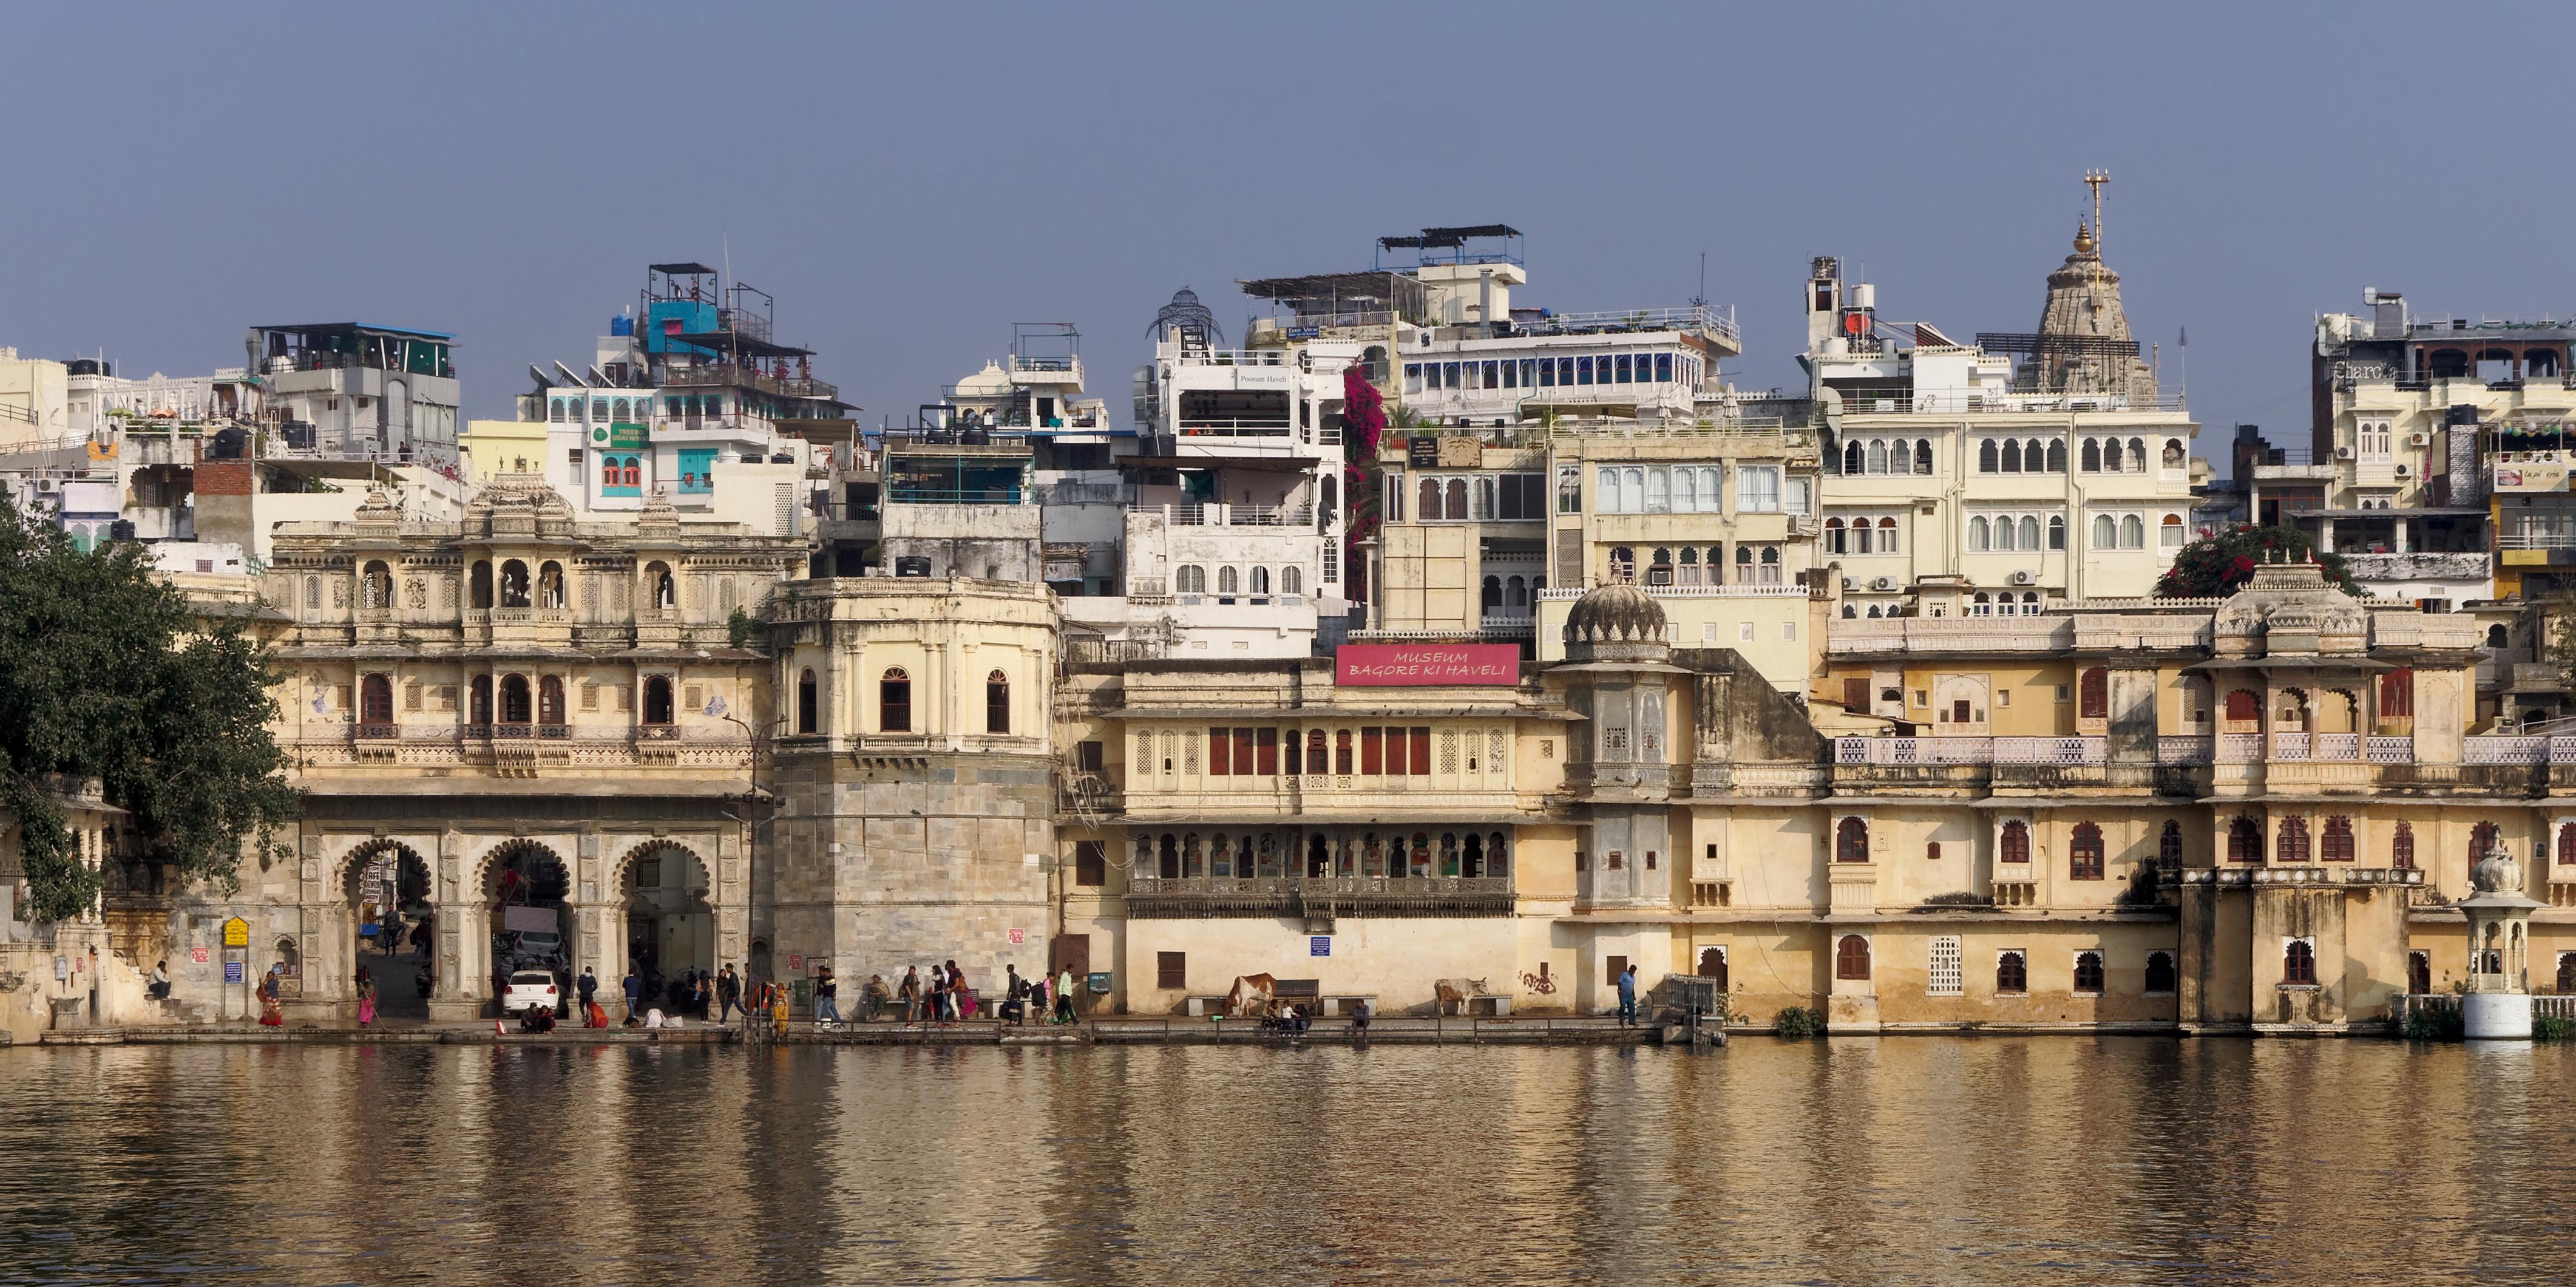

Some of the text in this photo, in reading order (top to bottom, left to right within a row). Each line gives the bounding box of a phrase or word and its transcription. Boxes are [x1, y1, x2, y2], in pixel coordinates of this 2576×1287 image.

[1394, 653, 1468, 662] MUSEUM
[1350, 665, 1506, 677] BAGORE KI HAVELI
